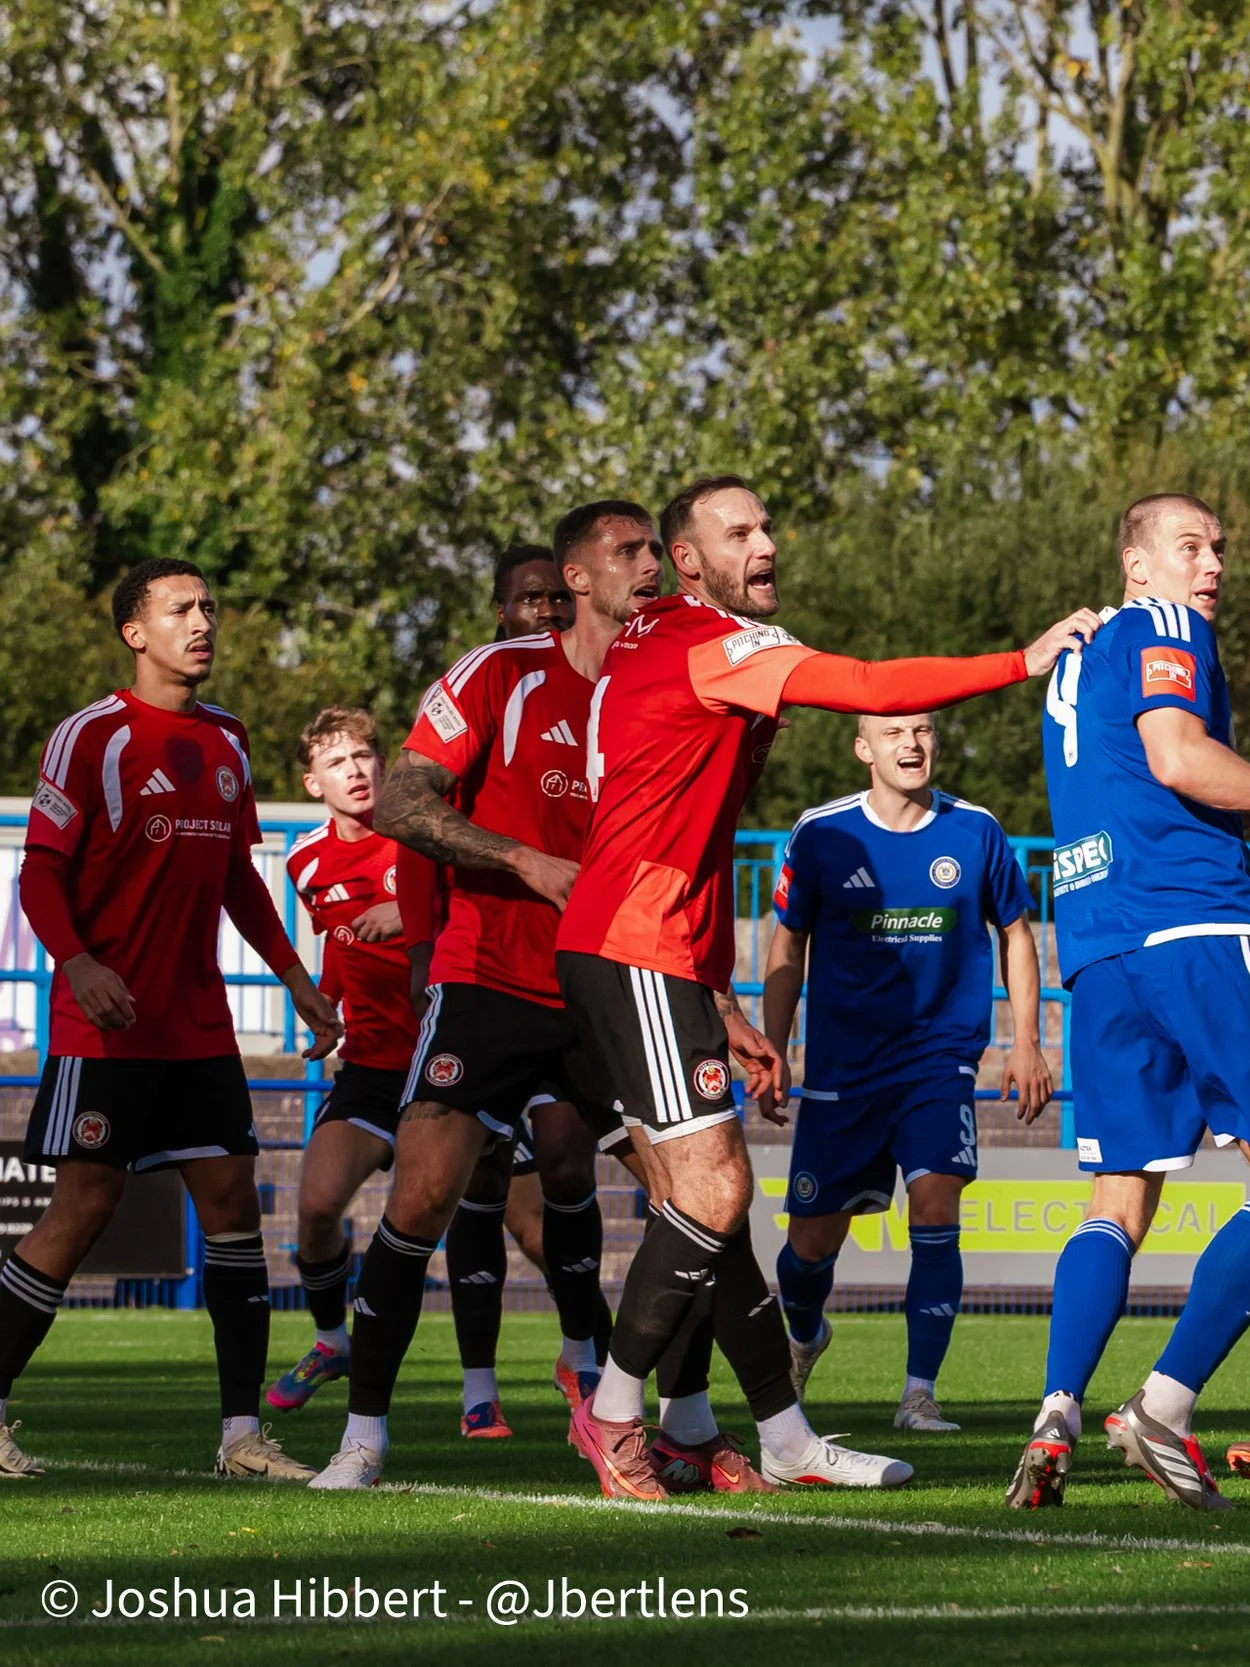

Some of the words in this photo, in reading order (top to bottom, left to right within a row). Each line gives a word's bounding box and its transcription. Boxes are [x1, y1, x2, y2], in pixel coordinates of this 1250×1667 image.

[731, 629, 771, 649] PITCHING
[175, 818, 209, 830] PROJECT
[871, 912, 943, 930] Pinnacle
[872, 935, 908, 944] Electrical
[909, 933, 943, 944] Supplies
[959, 1199, 1220, 1234] ELECTCAL
